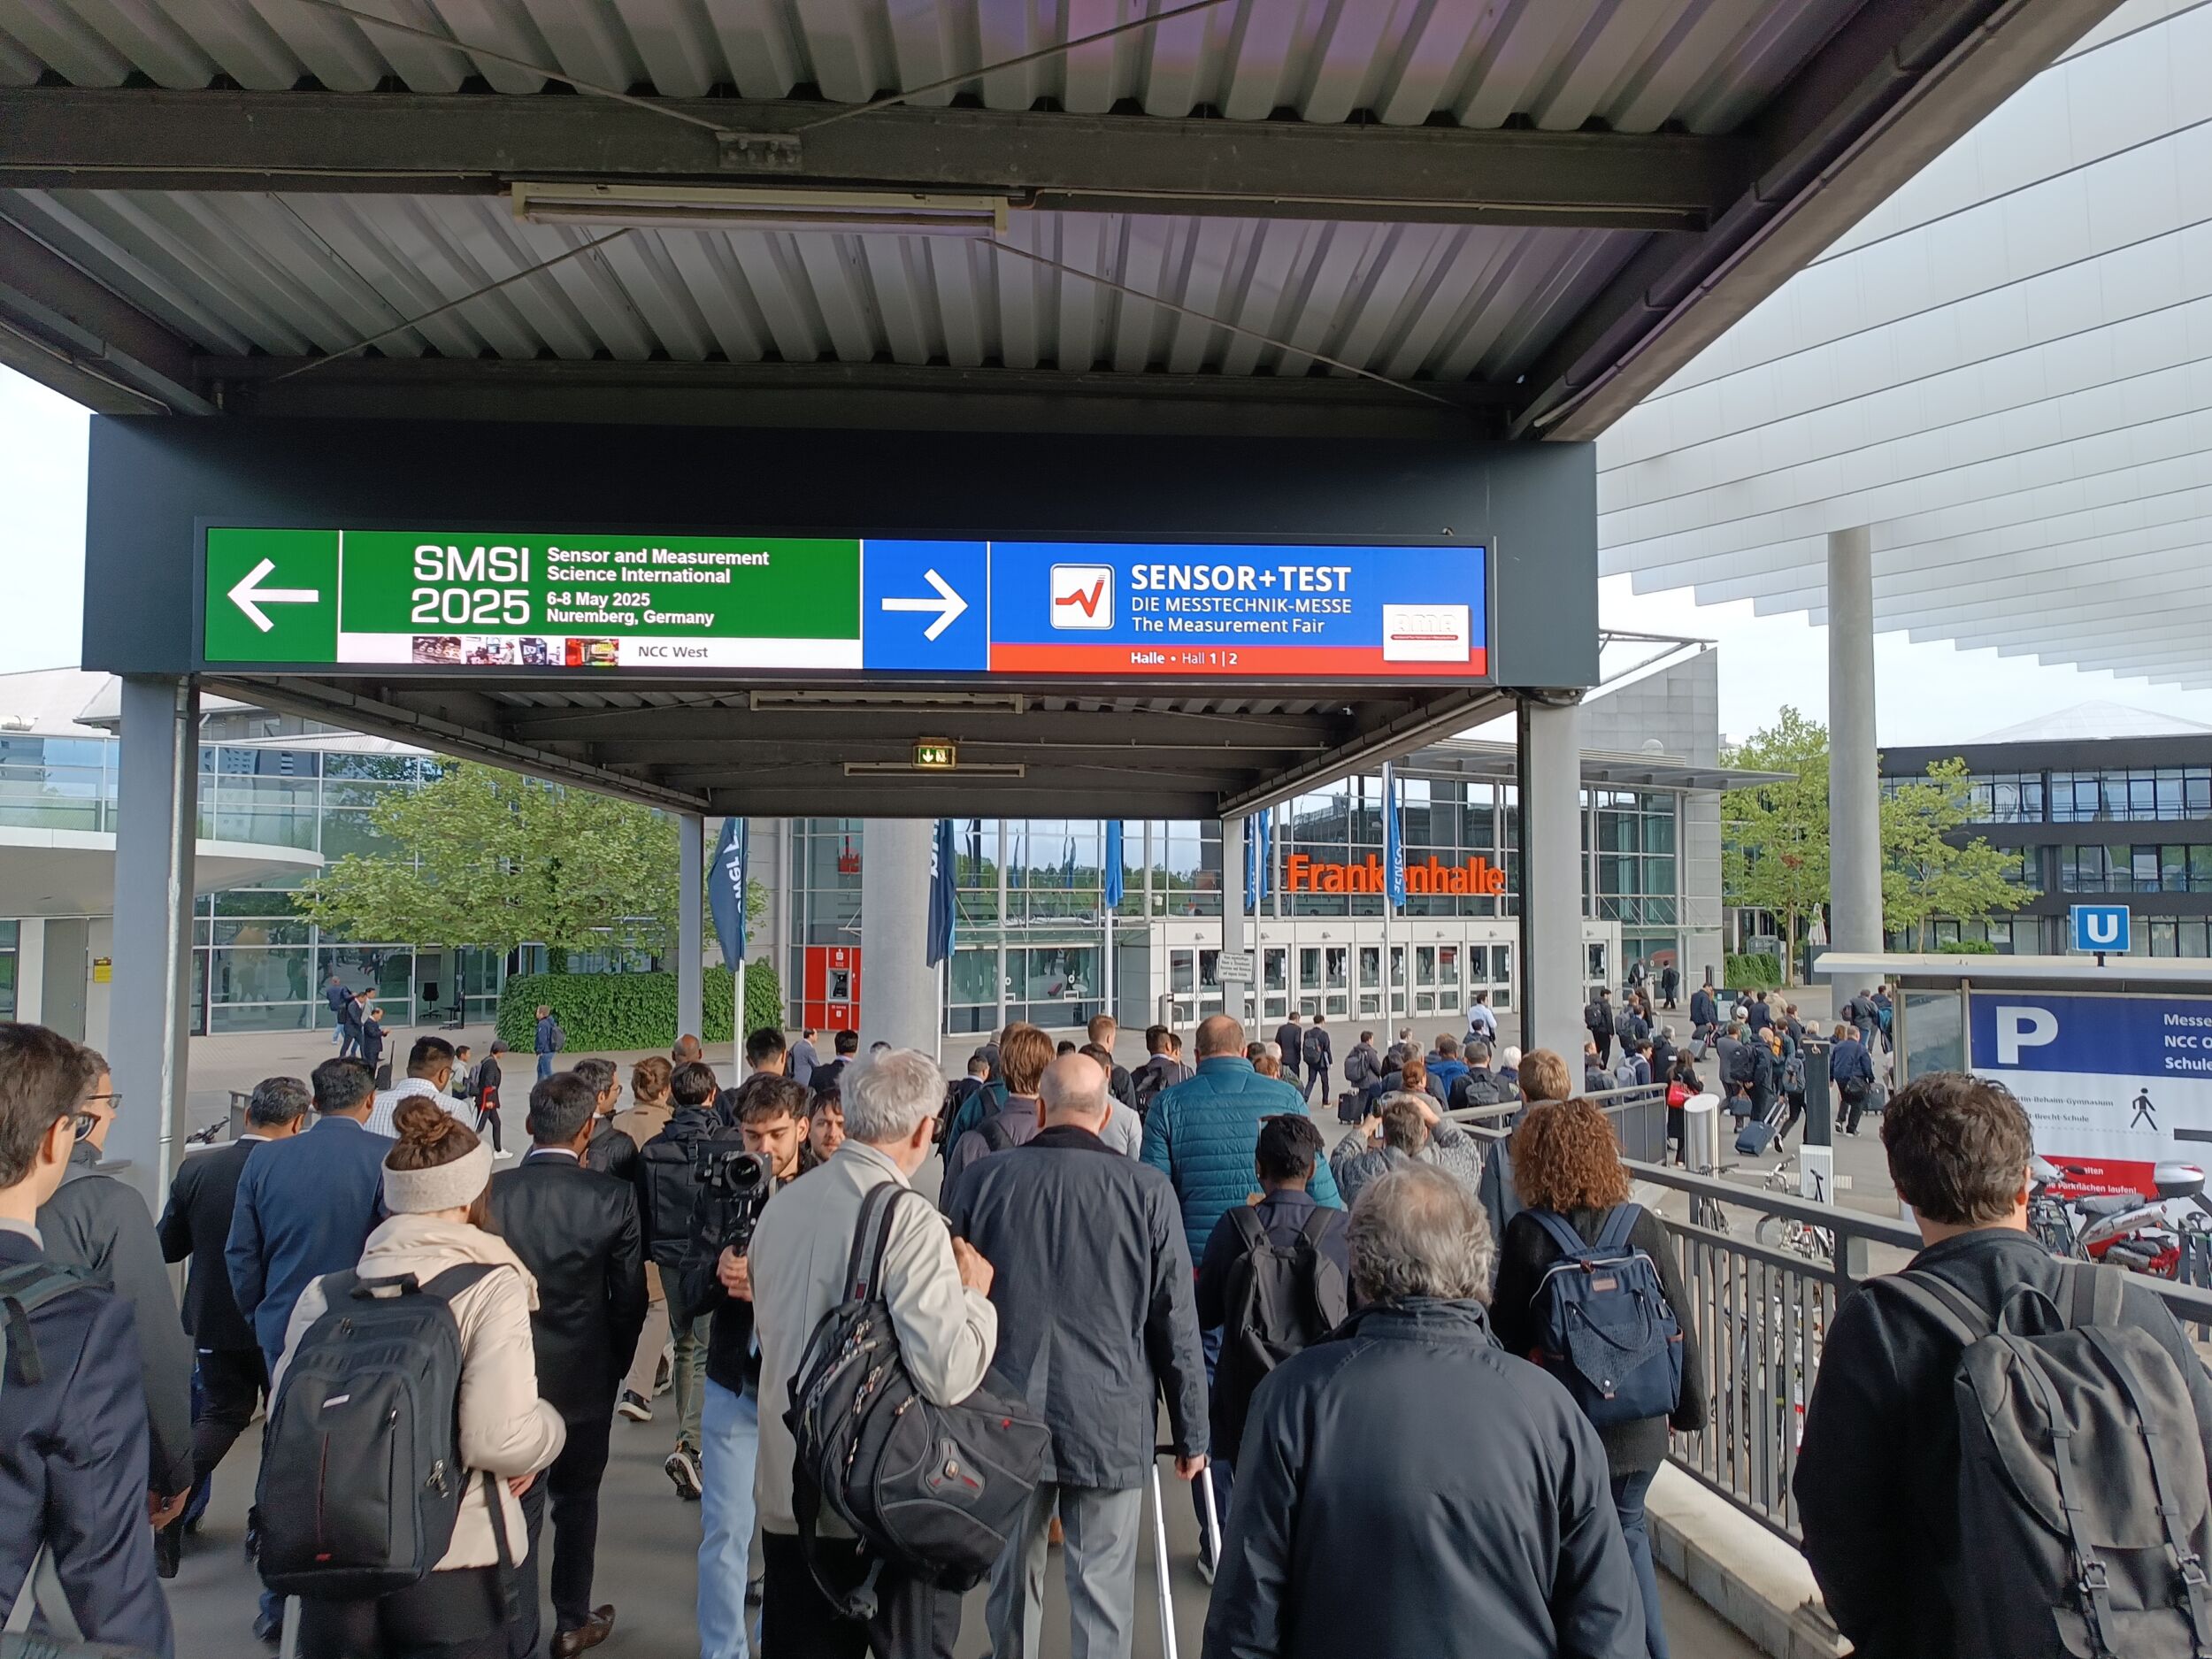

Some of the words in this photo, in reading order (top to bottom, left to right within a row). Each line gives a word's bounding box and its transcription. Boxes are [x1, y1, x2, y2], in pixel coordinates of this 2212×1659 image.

[413, 545, 529, 582] SMSI
[547, 547, 611, 563] Sensor
[614, 549, 647, 564] and
[651, 549, 770, 565] Measurement
[547, 565, 617, 581] Science
[621, 566, 731, 583] International
[1131, 565, 1352, 592] SENSOR+TEST
[411, 588, 530, 625] 2025
[547, 591, 572, 606] 6-8
[575, 591, 609, 608] May
[612, 593, 650, 607] 2025
[1132, 597, 1160, 611] DIE
[1165, 597, 1352, 613] MESSTECHNIK-MESSE
[547, 609, 639, 626] Nuremberg,
[643, 610, 714, 627] Germany
[1132, 617, 1164, 632] The
[1168, 618, 1288, 633] Measurement
[1292, 618, 1325, 634] Fair
[638, 646, 668, 658] NCC
[672, 647, 708, 658] West
[1131, 652, 1165, 664] Halle
[1182, 652, 1205, 664] Hall
[1210, 653, 1217, 664] 1
[1229, 653, 1238, 664] 2
[1287, 852, 1506, 895] Franknhalle
[2087, 914, 2118, 943] U
[2163, 1013, 2212, 1026] Messe
[1996, 1006, 2059, 1064] P
[2164, 1035, 2197, 1048] NCC
